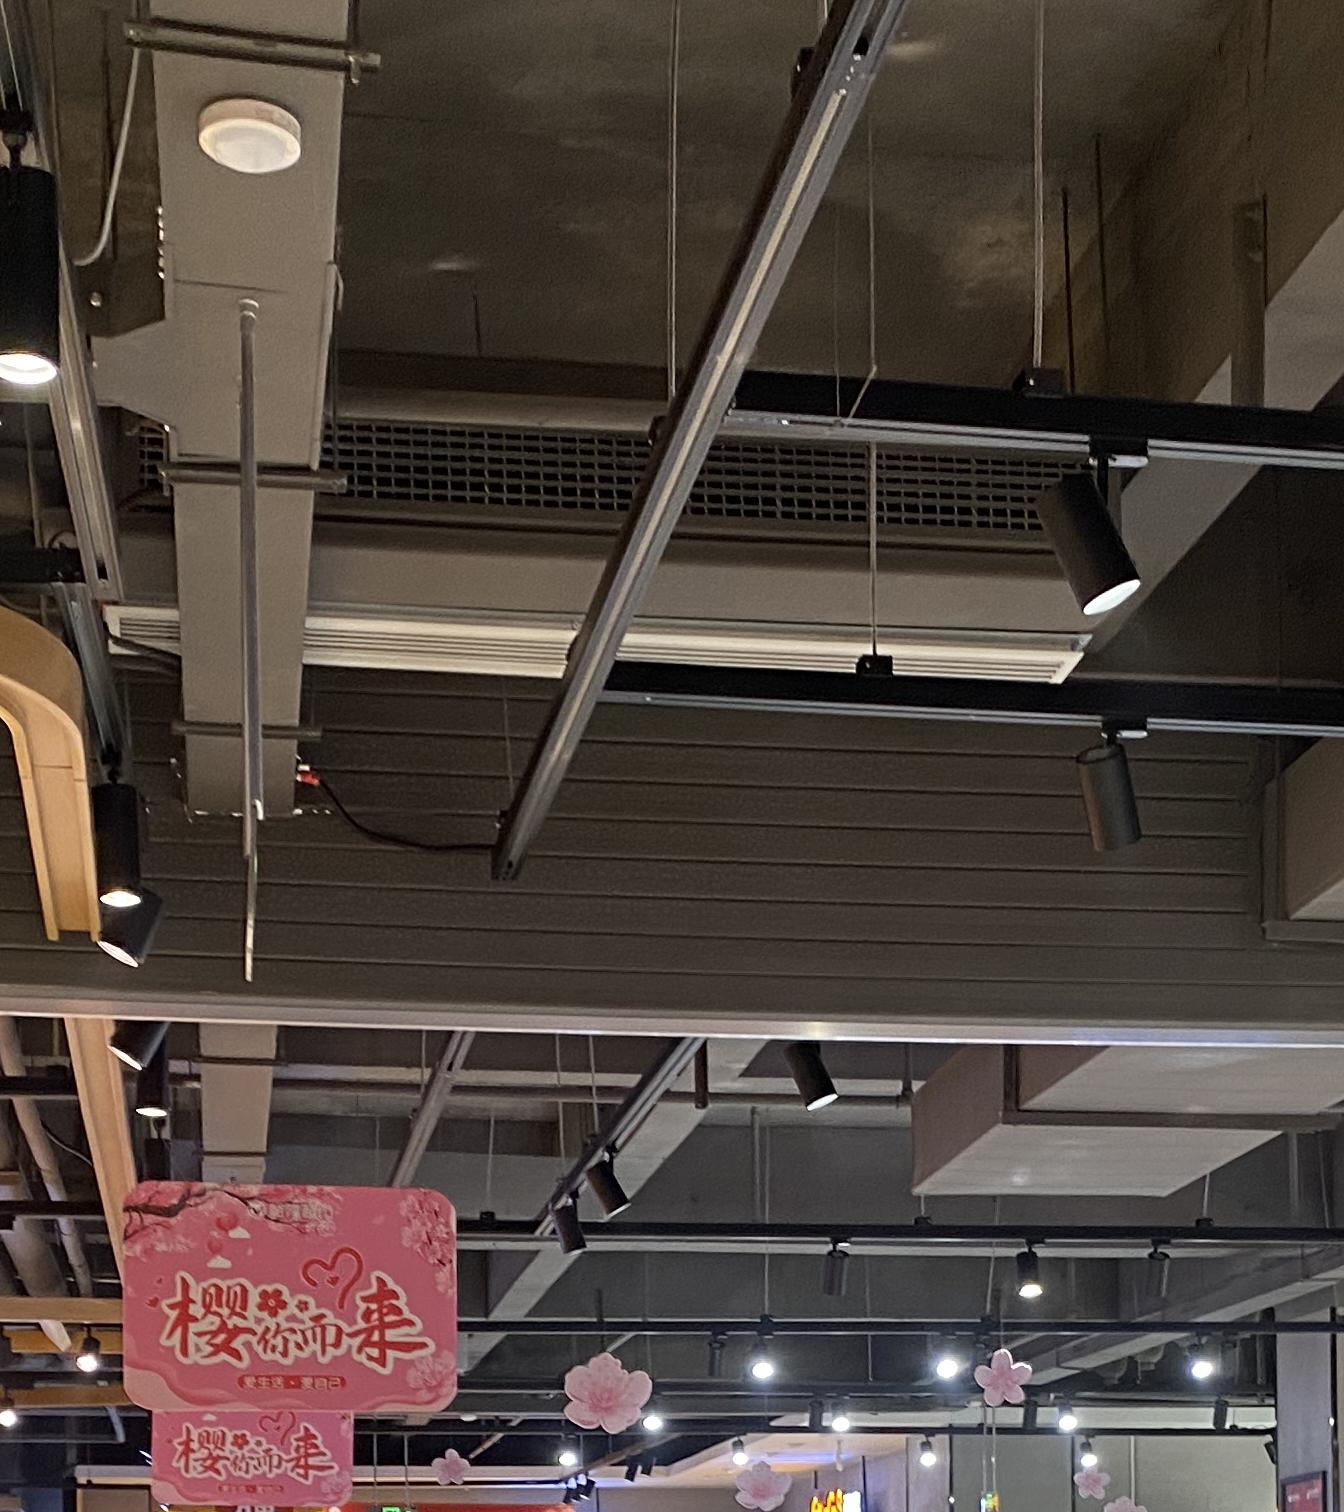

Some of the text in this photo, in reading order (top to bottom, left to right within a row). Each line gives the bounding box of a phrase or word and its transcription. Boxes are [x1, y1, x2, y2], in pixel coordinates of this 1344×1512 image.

[164, 1275, 431, 1369] 樱你而来
[175, 1424, 337, 1482] 樱你而来
